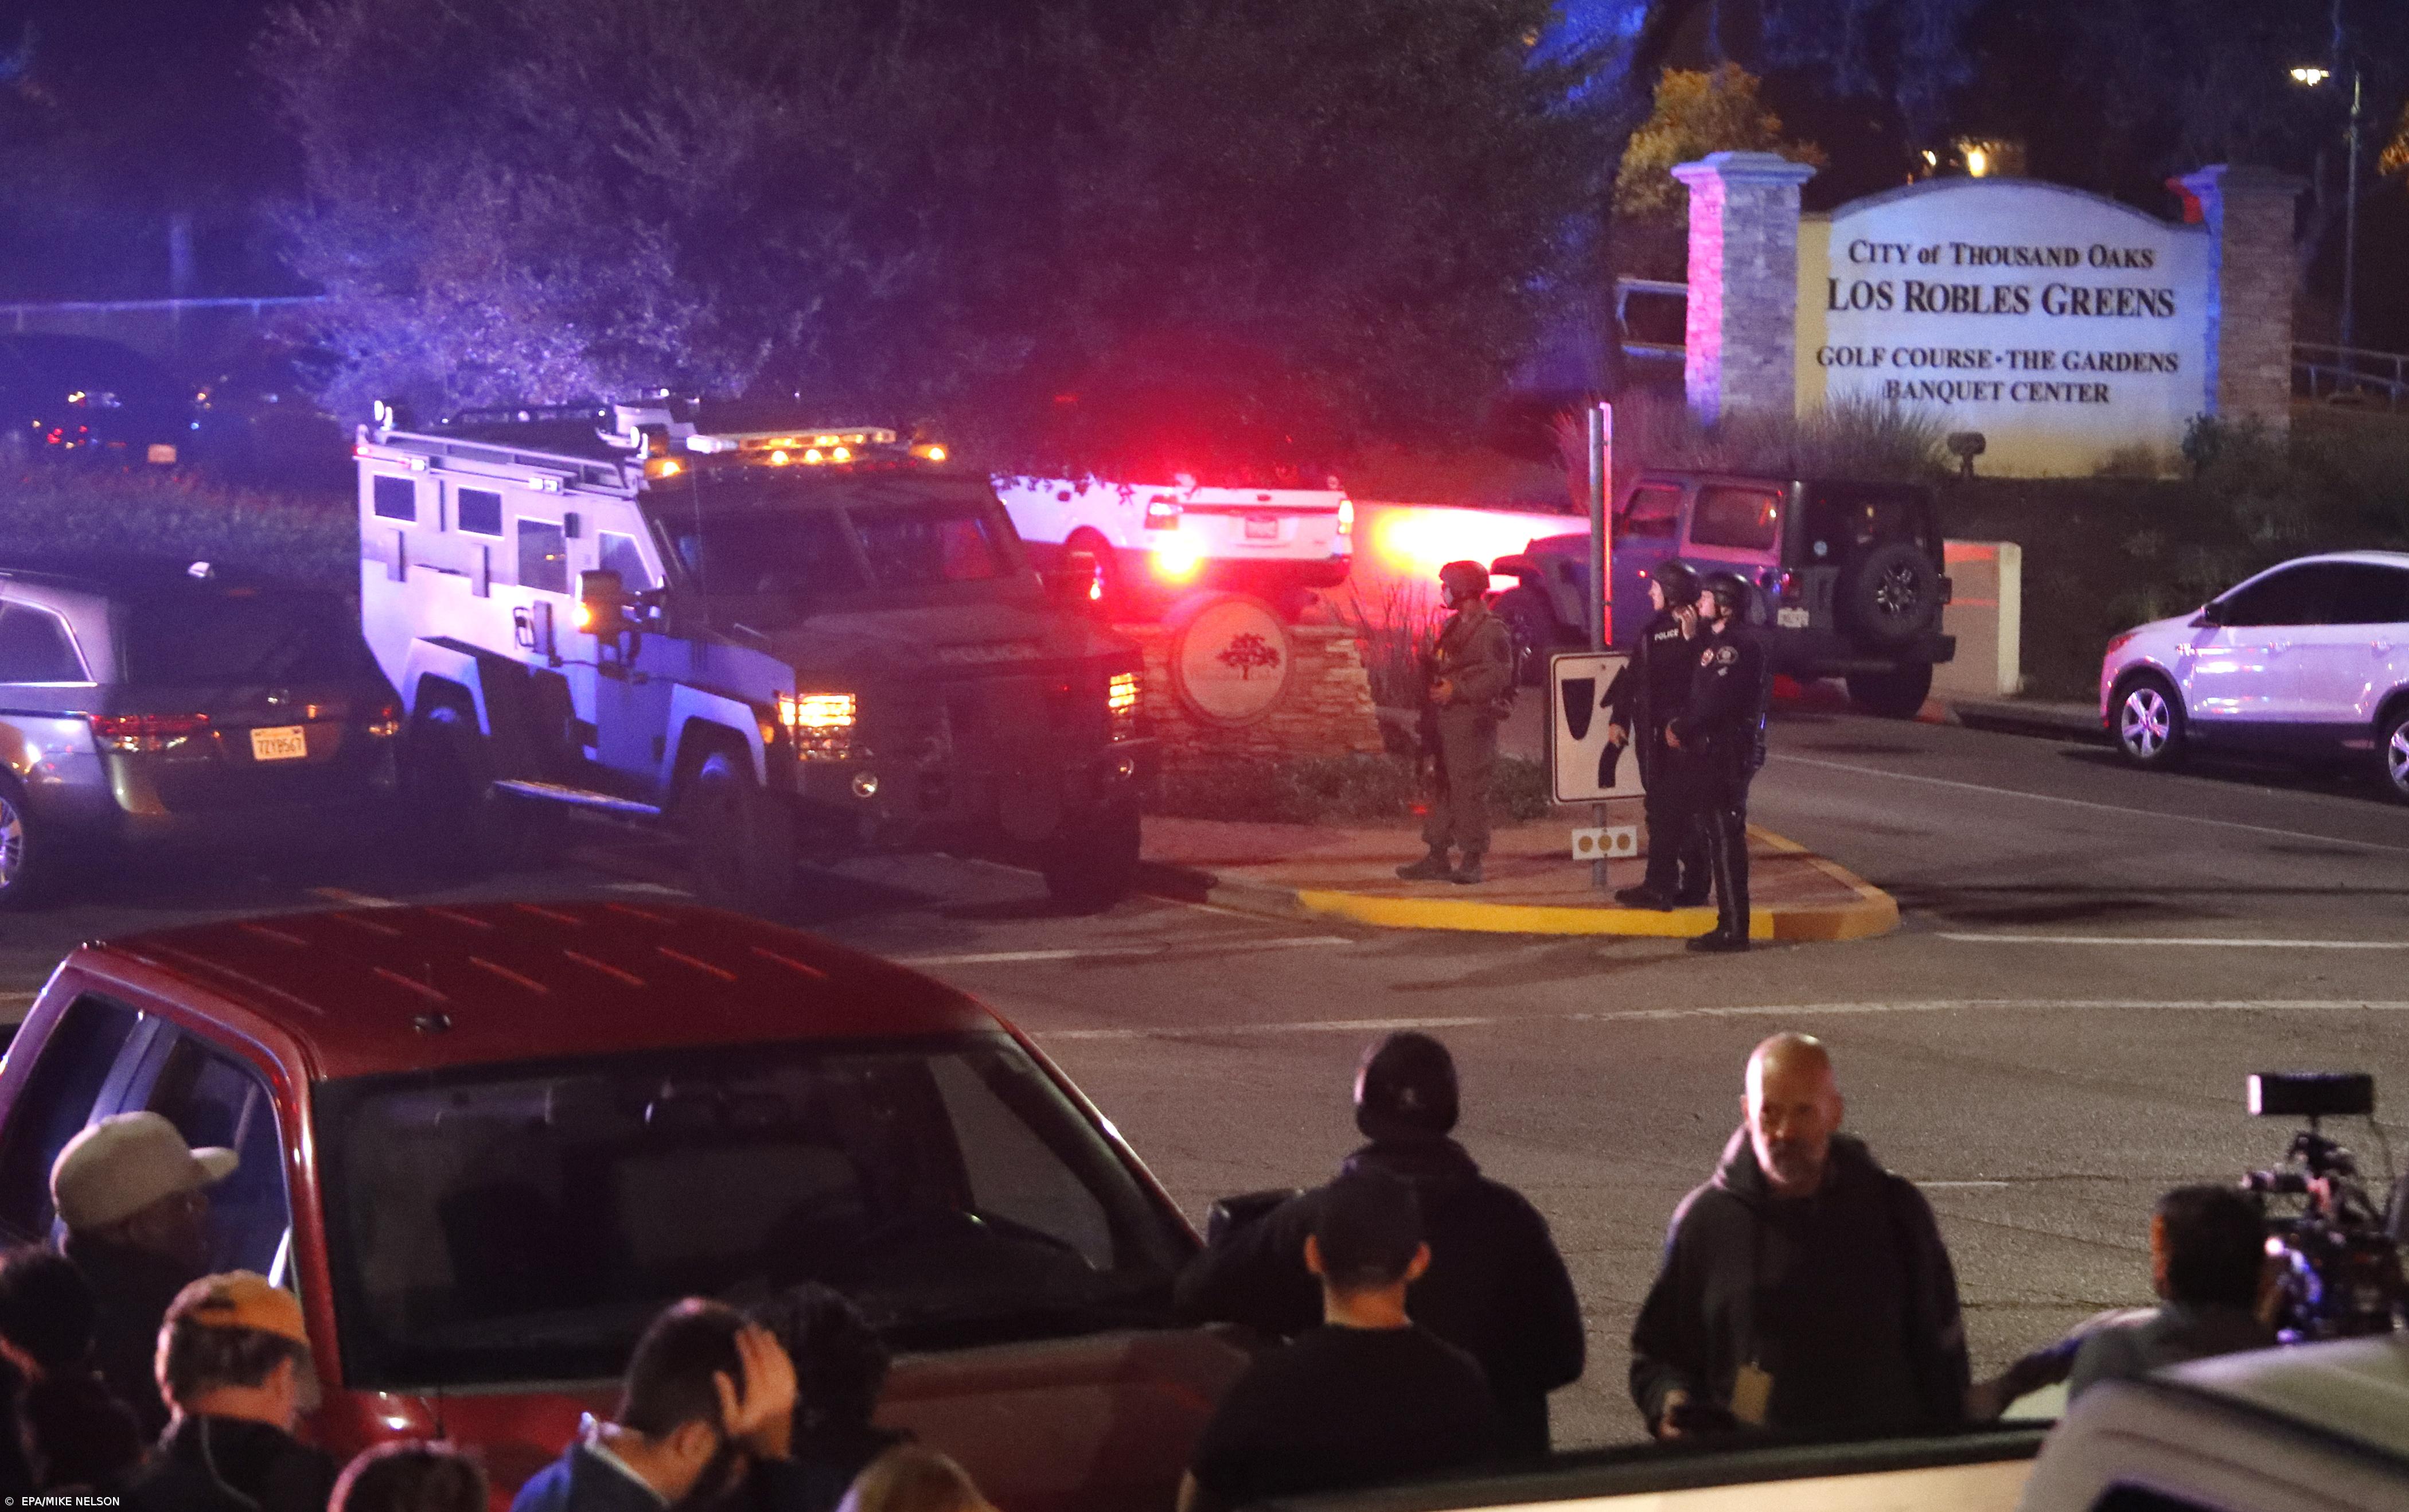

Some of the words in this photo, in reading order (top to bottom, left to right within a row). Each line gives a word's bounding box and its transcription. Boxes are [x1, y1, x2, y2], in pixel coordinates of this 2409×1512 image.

[1848, 239, 1912, 264] CITY
[1917, 244, 1941, 264] of
[1950, 241, 2080, 267] THOUSAND
[2088, 243, 2155, 268] OAKS
[1827, 277, 1893, 311] LOS
[1903, 279, 2030, 314] ROBLES
[2041, 283, 2175, 318] GREENS
[1816, 345, 1886, 368] GOLF
[1892, 346, 1993, 369] COURSE
[2006, 350, 2056, 370] THE
[2062, 350, 2178, 373] GARDENS
[1885, 379, 2005, 404] BANQUET
[2010, 381, 2110, 403] CENTER
[1654, 628, 1679, 641] POLICE
